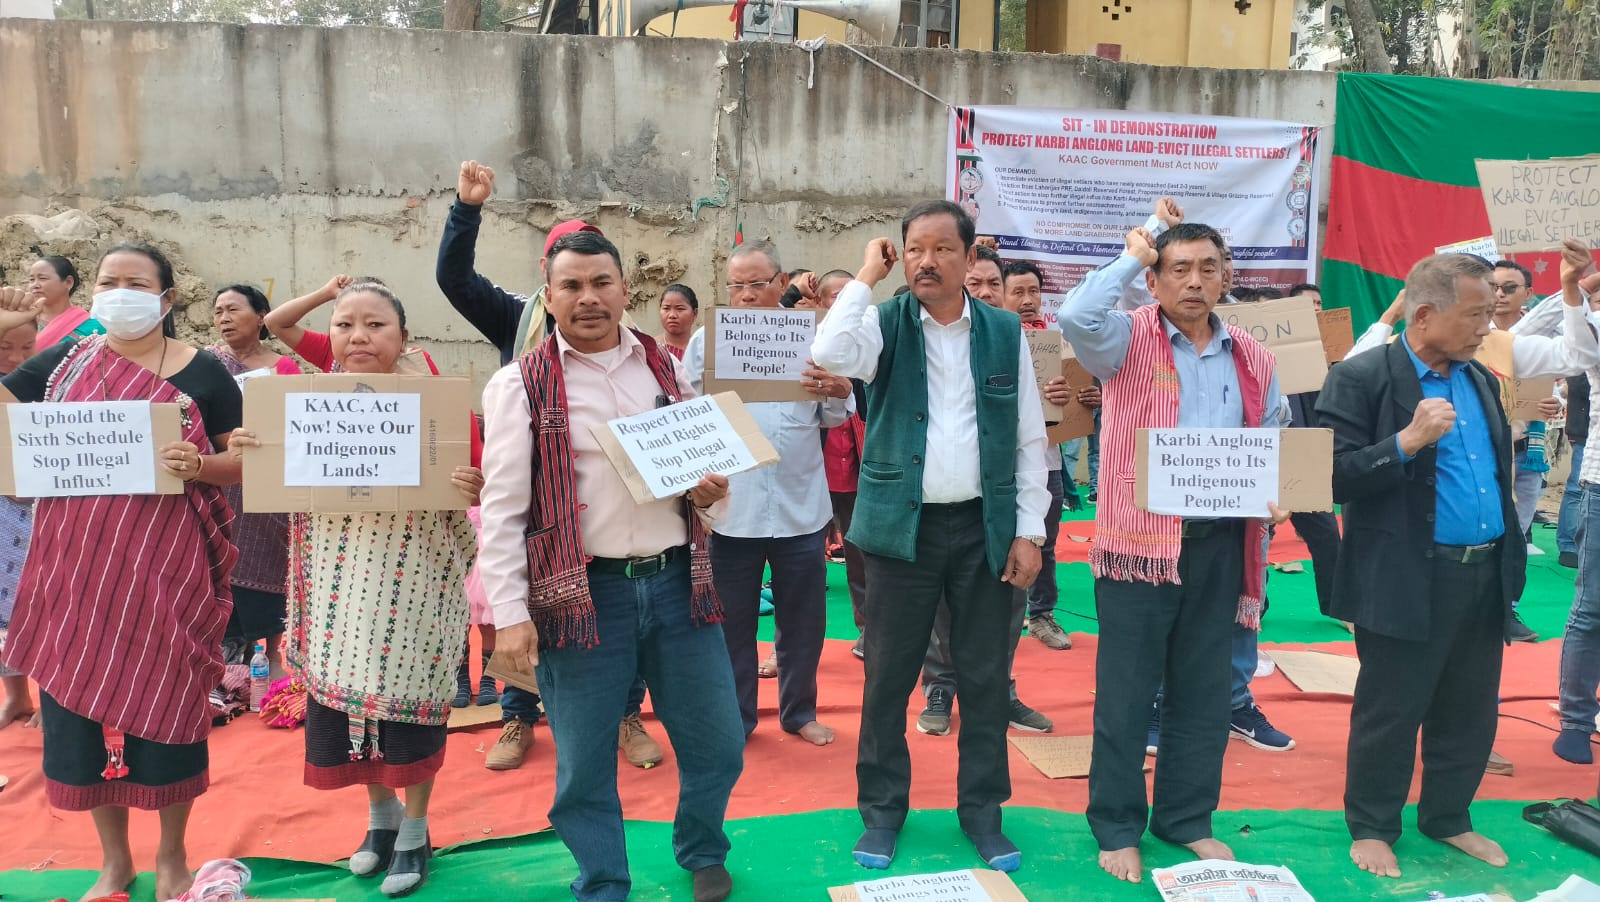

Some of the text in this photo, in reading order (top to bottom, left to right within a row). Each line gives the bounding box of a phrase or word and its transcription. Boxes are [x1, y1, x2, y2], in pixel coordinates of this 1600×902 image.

[1062, 118, 1083, 132] SIT
[1094, 120, 1107, 133] IN
[1110, 120, 1217, 139] DEMONSTRATION
[982, 132, 1033, 148] PROTECT
[1035, 135, 1069, 150] KARBI
[1072, 138, 1123, 152] ANGLONG
[1125, 139, 1190, 156] LAND-EVICT
[1191, 143, 1233, 158] ILLEGAL
[1058, 154, 1218, 170] KAAC Government Must Act NOW
[1511, 164, 1598, 187] PROTECT
[1550, 188, 1600, 207] ANGLO
[1047, 221, 1090, 229] COMPROMISE
[1525, 208, 1570, 227] EVICT
[1496, 219, 1600, 247] ILLEGAL SETTLER
[999, 236, 1019, 246] Stand
[1050, 242, 1074, 253] Defend
[1076, 243, 1090, 252] Our
[1092, 244, 1122, 254] Homelan
[1254, 249, 1279, 258] people!
[720, 313, 811, 328] Karbi Anglong
[725, 330, 806, 343] Belongs to Its
[732, 346, 798, 360] Indigenous
[742, 362, 787, 376] People!
[304, 399, 400, 415] KAAC, Act
[30, 409, 126, 428] Uphold the
[617, 400, 713, 436] Respect Tribal
[289, 420, 415, 435] Now! Save Our
[635, 421, 717, 452] Land Rights
[18, 429, 144, 447] Sixth Schedule
[1155, 433, 1273, 450] Karbi Anglong
[306, 441, 396, 459] Indigenous
[650, 454, 684, 470] Stop
[683, 438, 727, 461] Illegal
[33, 452, 130, 471] Stop Illegal
[322, 463, 379, 478] Lands!
[1161, 453, 1266, 470] Belongs to Its
[660, 454, 741, 489] Occupation!
[53, 474, 112, 489] Influx!
[1170, 474, 1256, 490] Indigenous
[1184, 495, 1241, 511] People!
[862, 874, 970, 894] Karbi Anglong
[873, 890, 931, 902] Belongs
[952, 884, 971, 893] Its
